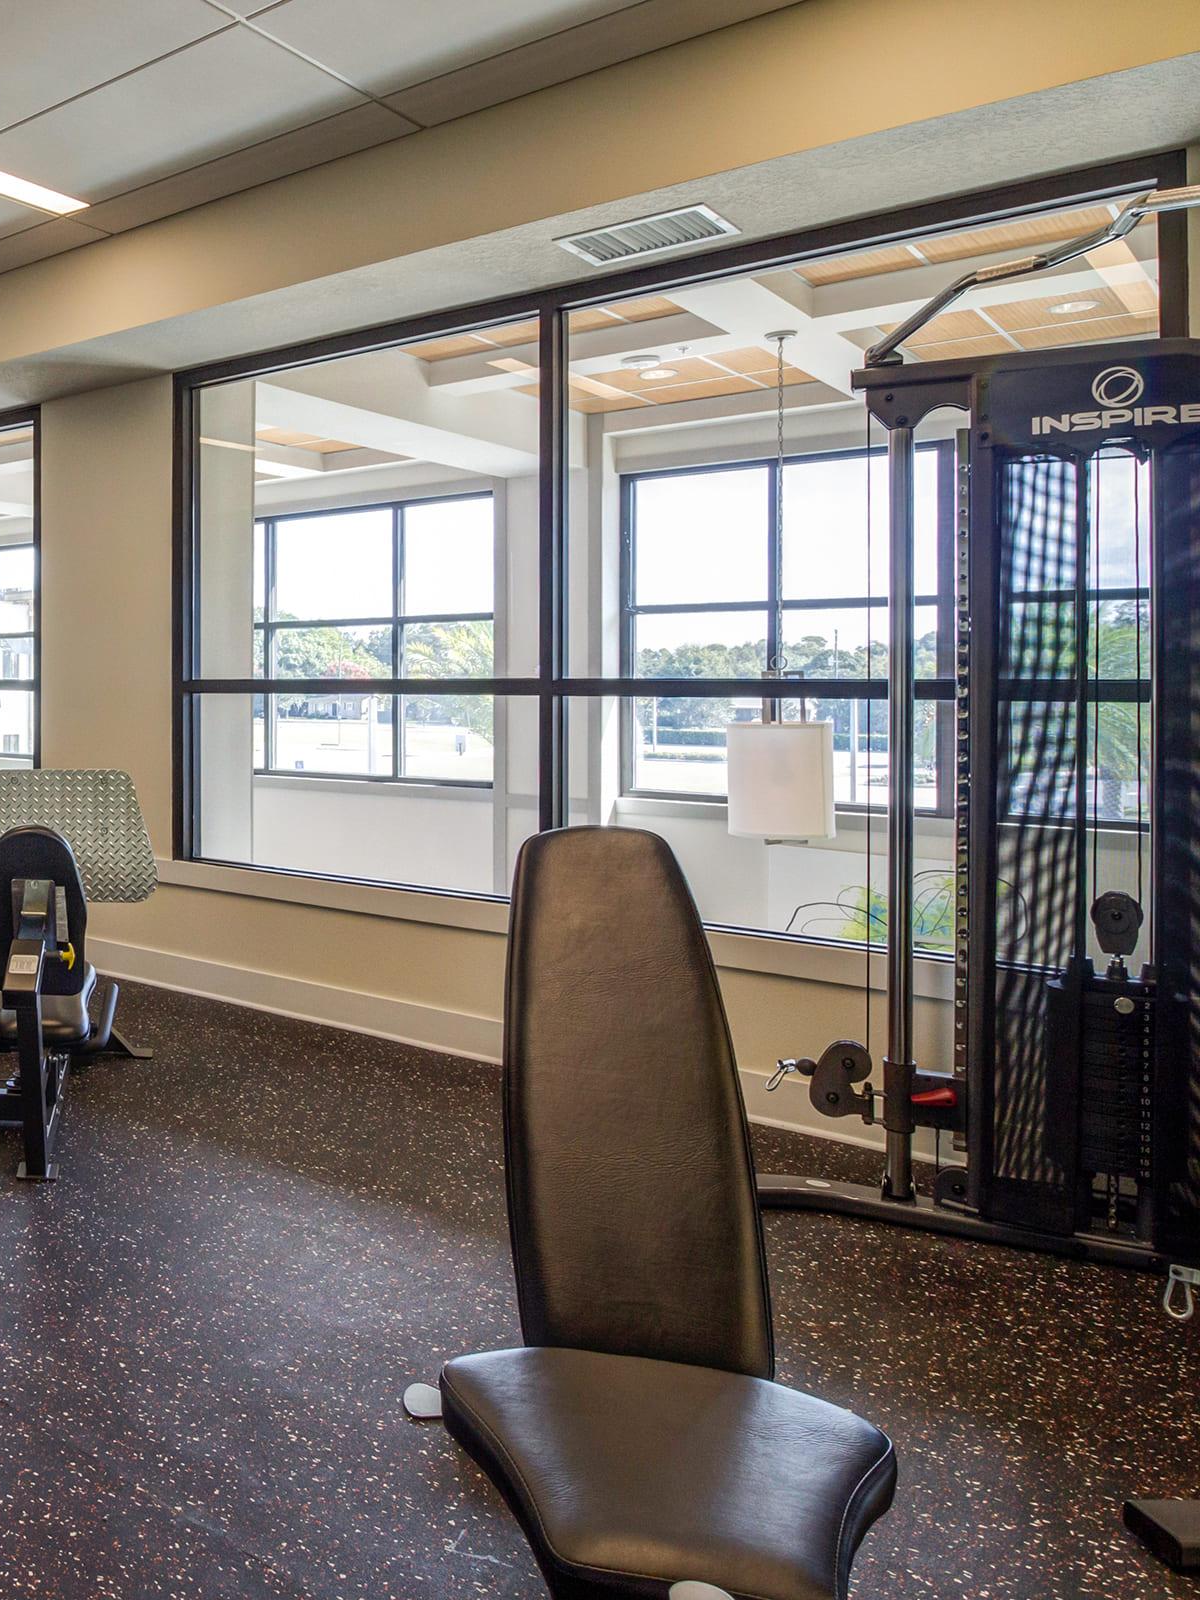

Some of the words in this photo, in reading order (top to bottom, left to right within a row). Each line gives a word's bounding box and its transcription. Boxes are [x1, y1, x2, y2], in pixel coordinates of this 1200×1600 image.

[1031, 403, 1200, 436] INSPIRE
[1141, 1098, 1151, 1106] 10
[1141, 1134, 1151, 1143] 13
